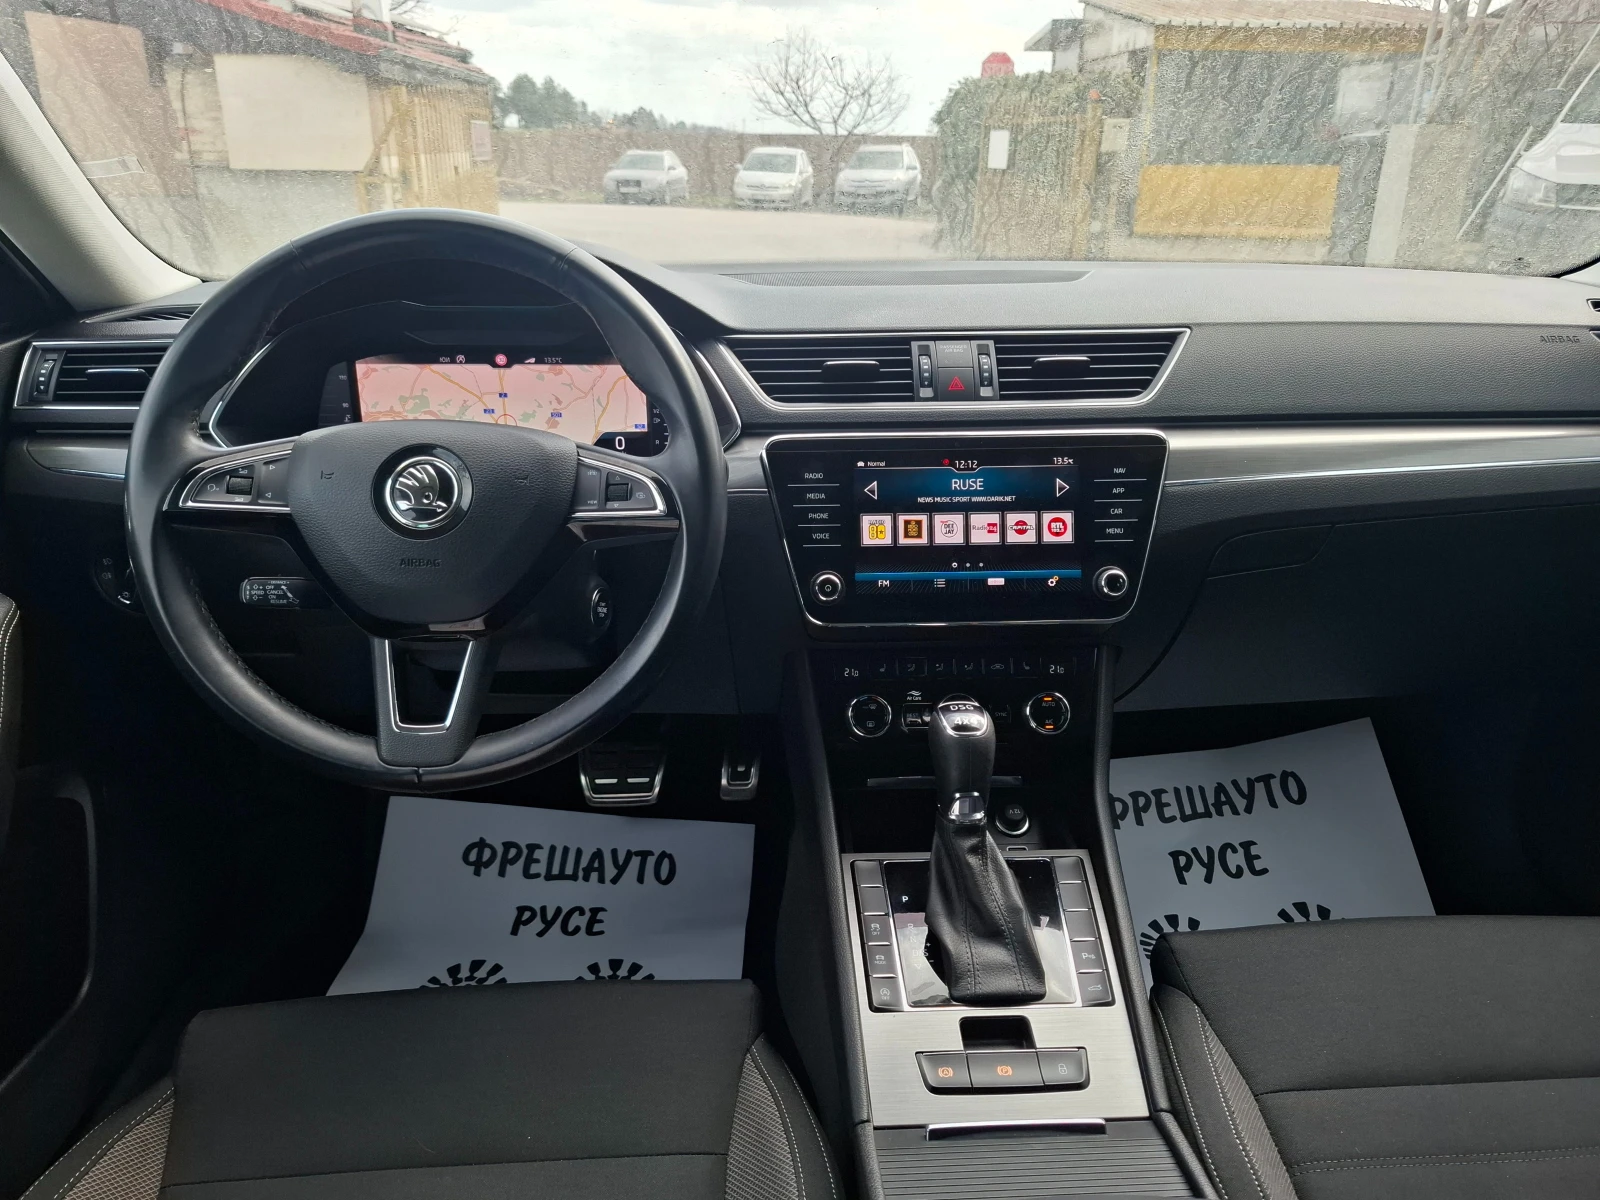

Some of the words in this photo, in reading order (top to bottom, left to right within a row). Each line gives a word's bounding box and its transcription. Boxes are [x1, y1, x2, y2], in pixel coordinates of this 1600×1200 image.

[1540, 335, 1580, 344] AIRBAG
[615, 436, 626, 450] 0
[954, 460, 978, 469] 12:12
[951, 478, 985, 491] RUSE
[971, 495, 1016, 503] WWW.DARIK.NET
[400, 559, 441, 568] AIRBAG
[878, 579, 890, 588] FM
[461, 836, 678, 886] ФРЕШАУТО
[1167, 839, 1270, 886] РУСЕ
[902, 895, 909, 903] P
[509, 904, 609, 938] РУСЕ
